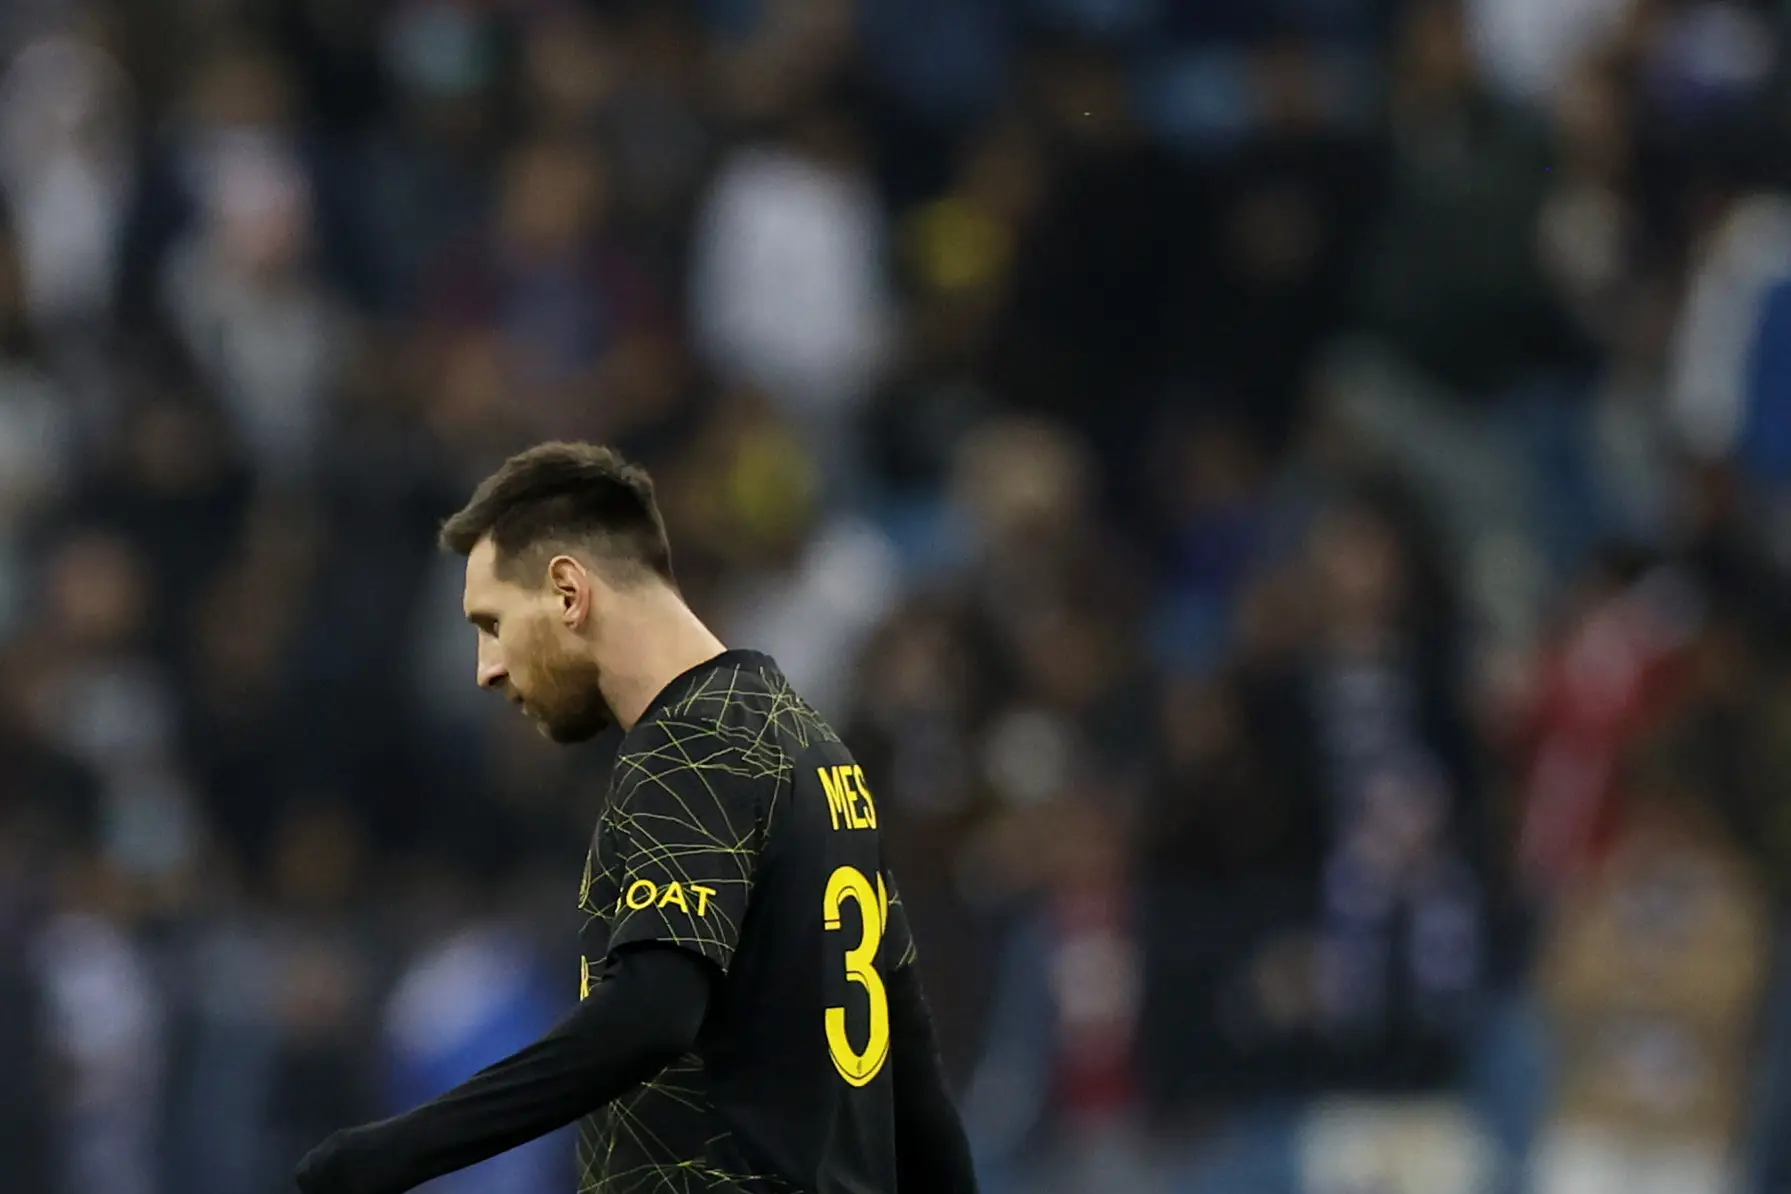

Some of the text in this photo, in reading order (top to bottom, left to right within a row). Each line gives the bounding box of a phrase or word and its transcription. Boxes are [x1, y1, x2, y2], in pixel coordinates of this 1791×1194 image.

[817, 764, 877, 830] MES
[615, 879, 717, 917] OAT
[823, 866, 890, 1087] 3
